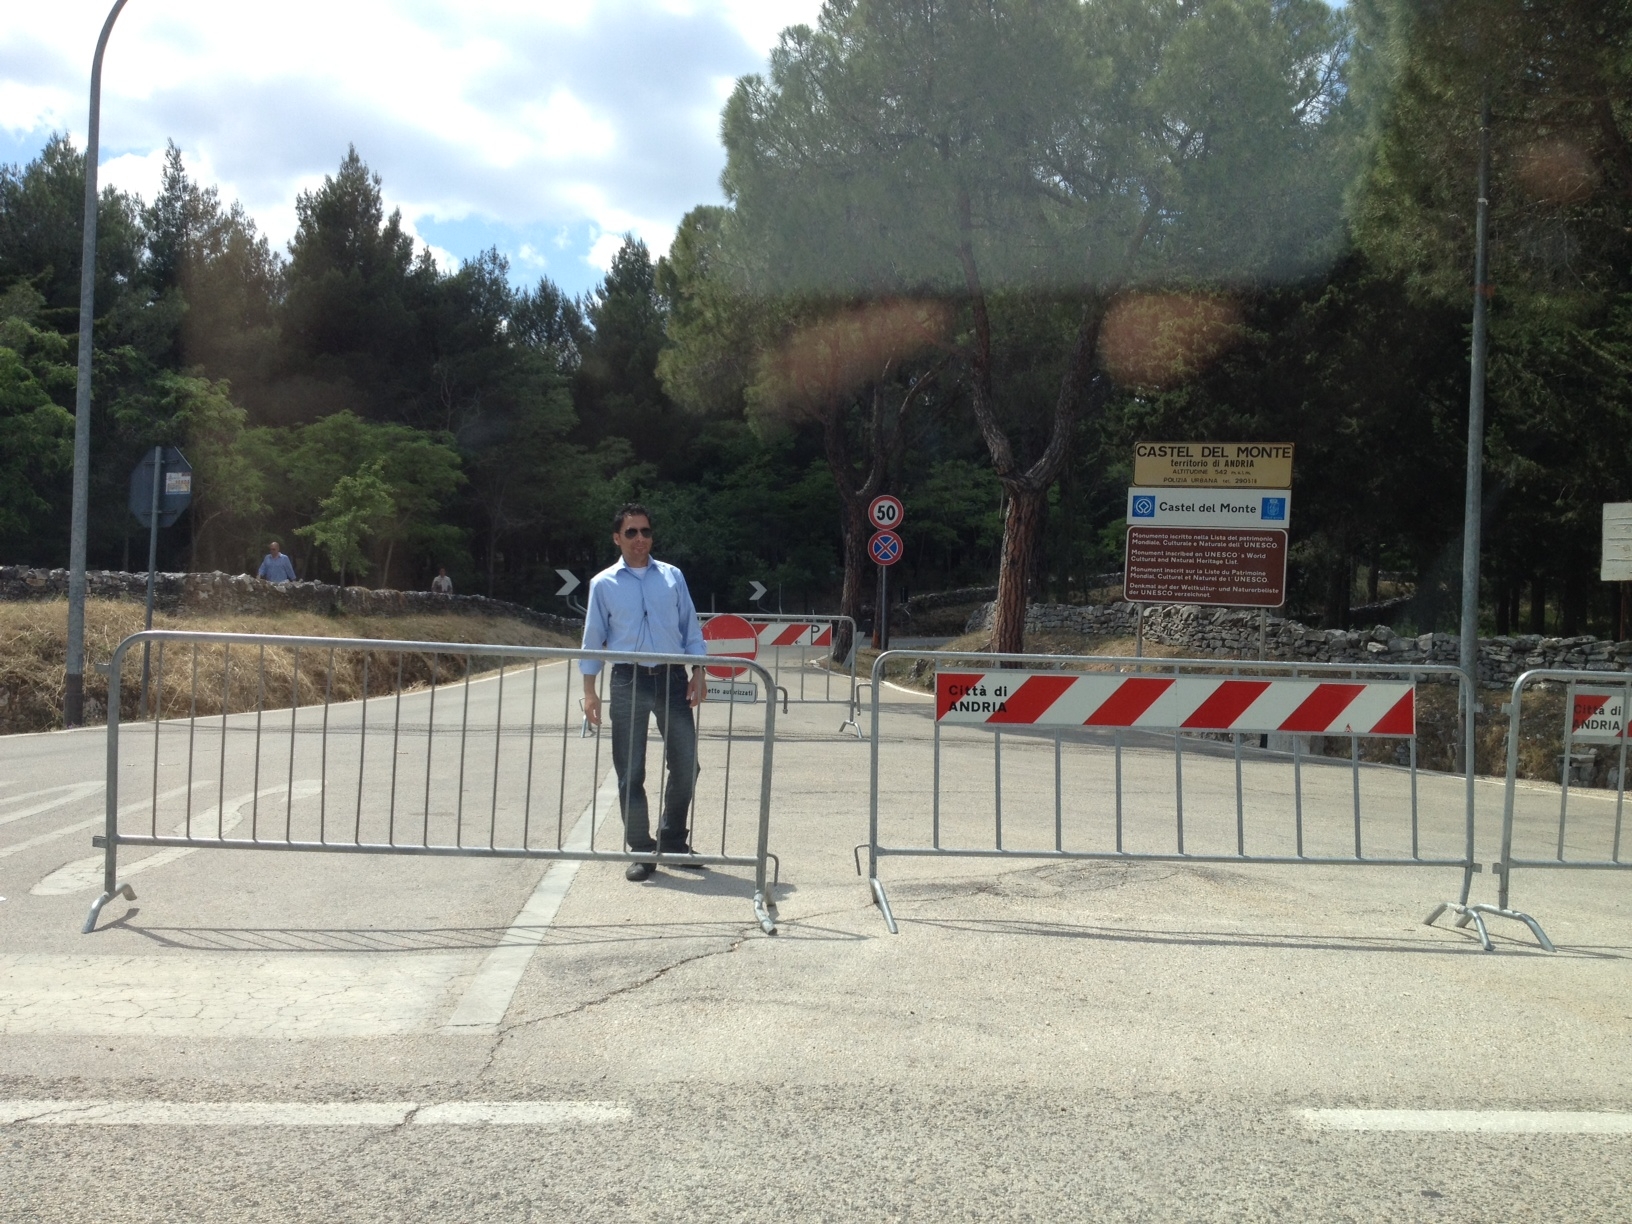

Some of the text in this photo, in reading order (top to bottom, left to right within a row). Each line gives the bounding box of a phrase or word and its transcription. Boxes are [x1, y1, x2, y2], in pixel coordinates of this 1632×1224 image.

[1136, 446, 1292, 458] CASTEL DEL MONTE
[1170, 459, 1254, 468] territorio di ANDRIA
[877, 505, 896, 520] 50
[1159, 502, 1256, 513] Castel del Monte
[811, 624, 820, 645] P
[948, 685, 1007, 696] Città di
[948, 701, 1007, 712] ANDRIA
[1574, 704, 1621, 716] Città di
[1572, 719, 1620, 730] ANDRIA
